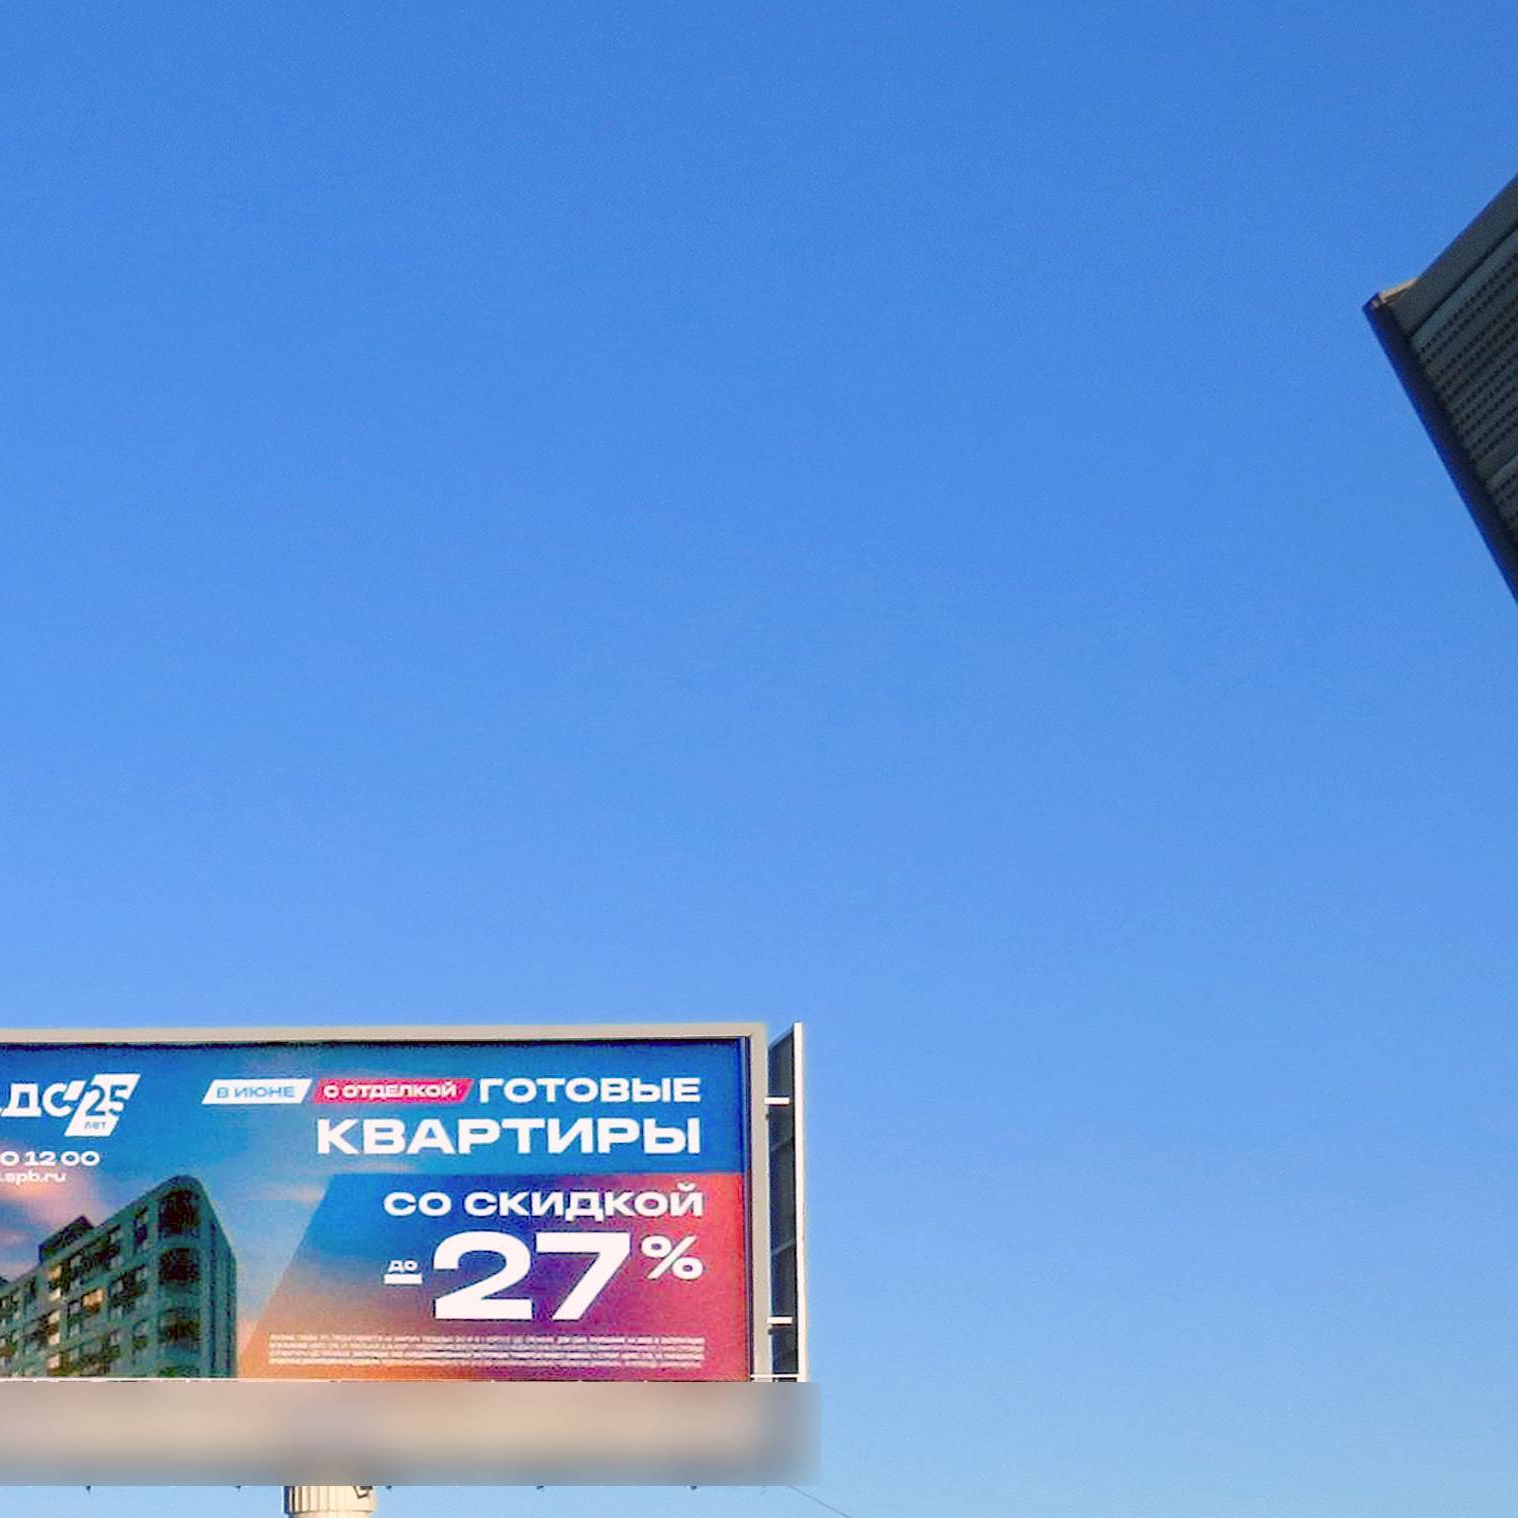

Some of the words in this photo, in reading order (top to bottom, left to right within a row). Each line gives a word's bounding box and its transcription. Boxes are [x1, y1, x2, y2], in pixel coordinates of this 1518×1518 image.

[83, 1085, 129, 1115] 25
[217, 1087, 229, 1099] В
[234, 1086, 295, 1098] ИЮНЕ
[342, 1081, 458, 1100] ОТДЕЛКОЙ
[479, 1077, 701, 1103] ГОТОВЫЕ
[316, 1117, 701, 1155] КВАРТИРЫ
[24, 1151, 57, 1167] 12
[61, 1151, 101, 1167] 00
[383, 1191, 452, 1217] СО
[463, 1182, 704, 1222] СКИДКОЙ
